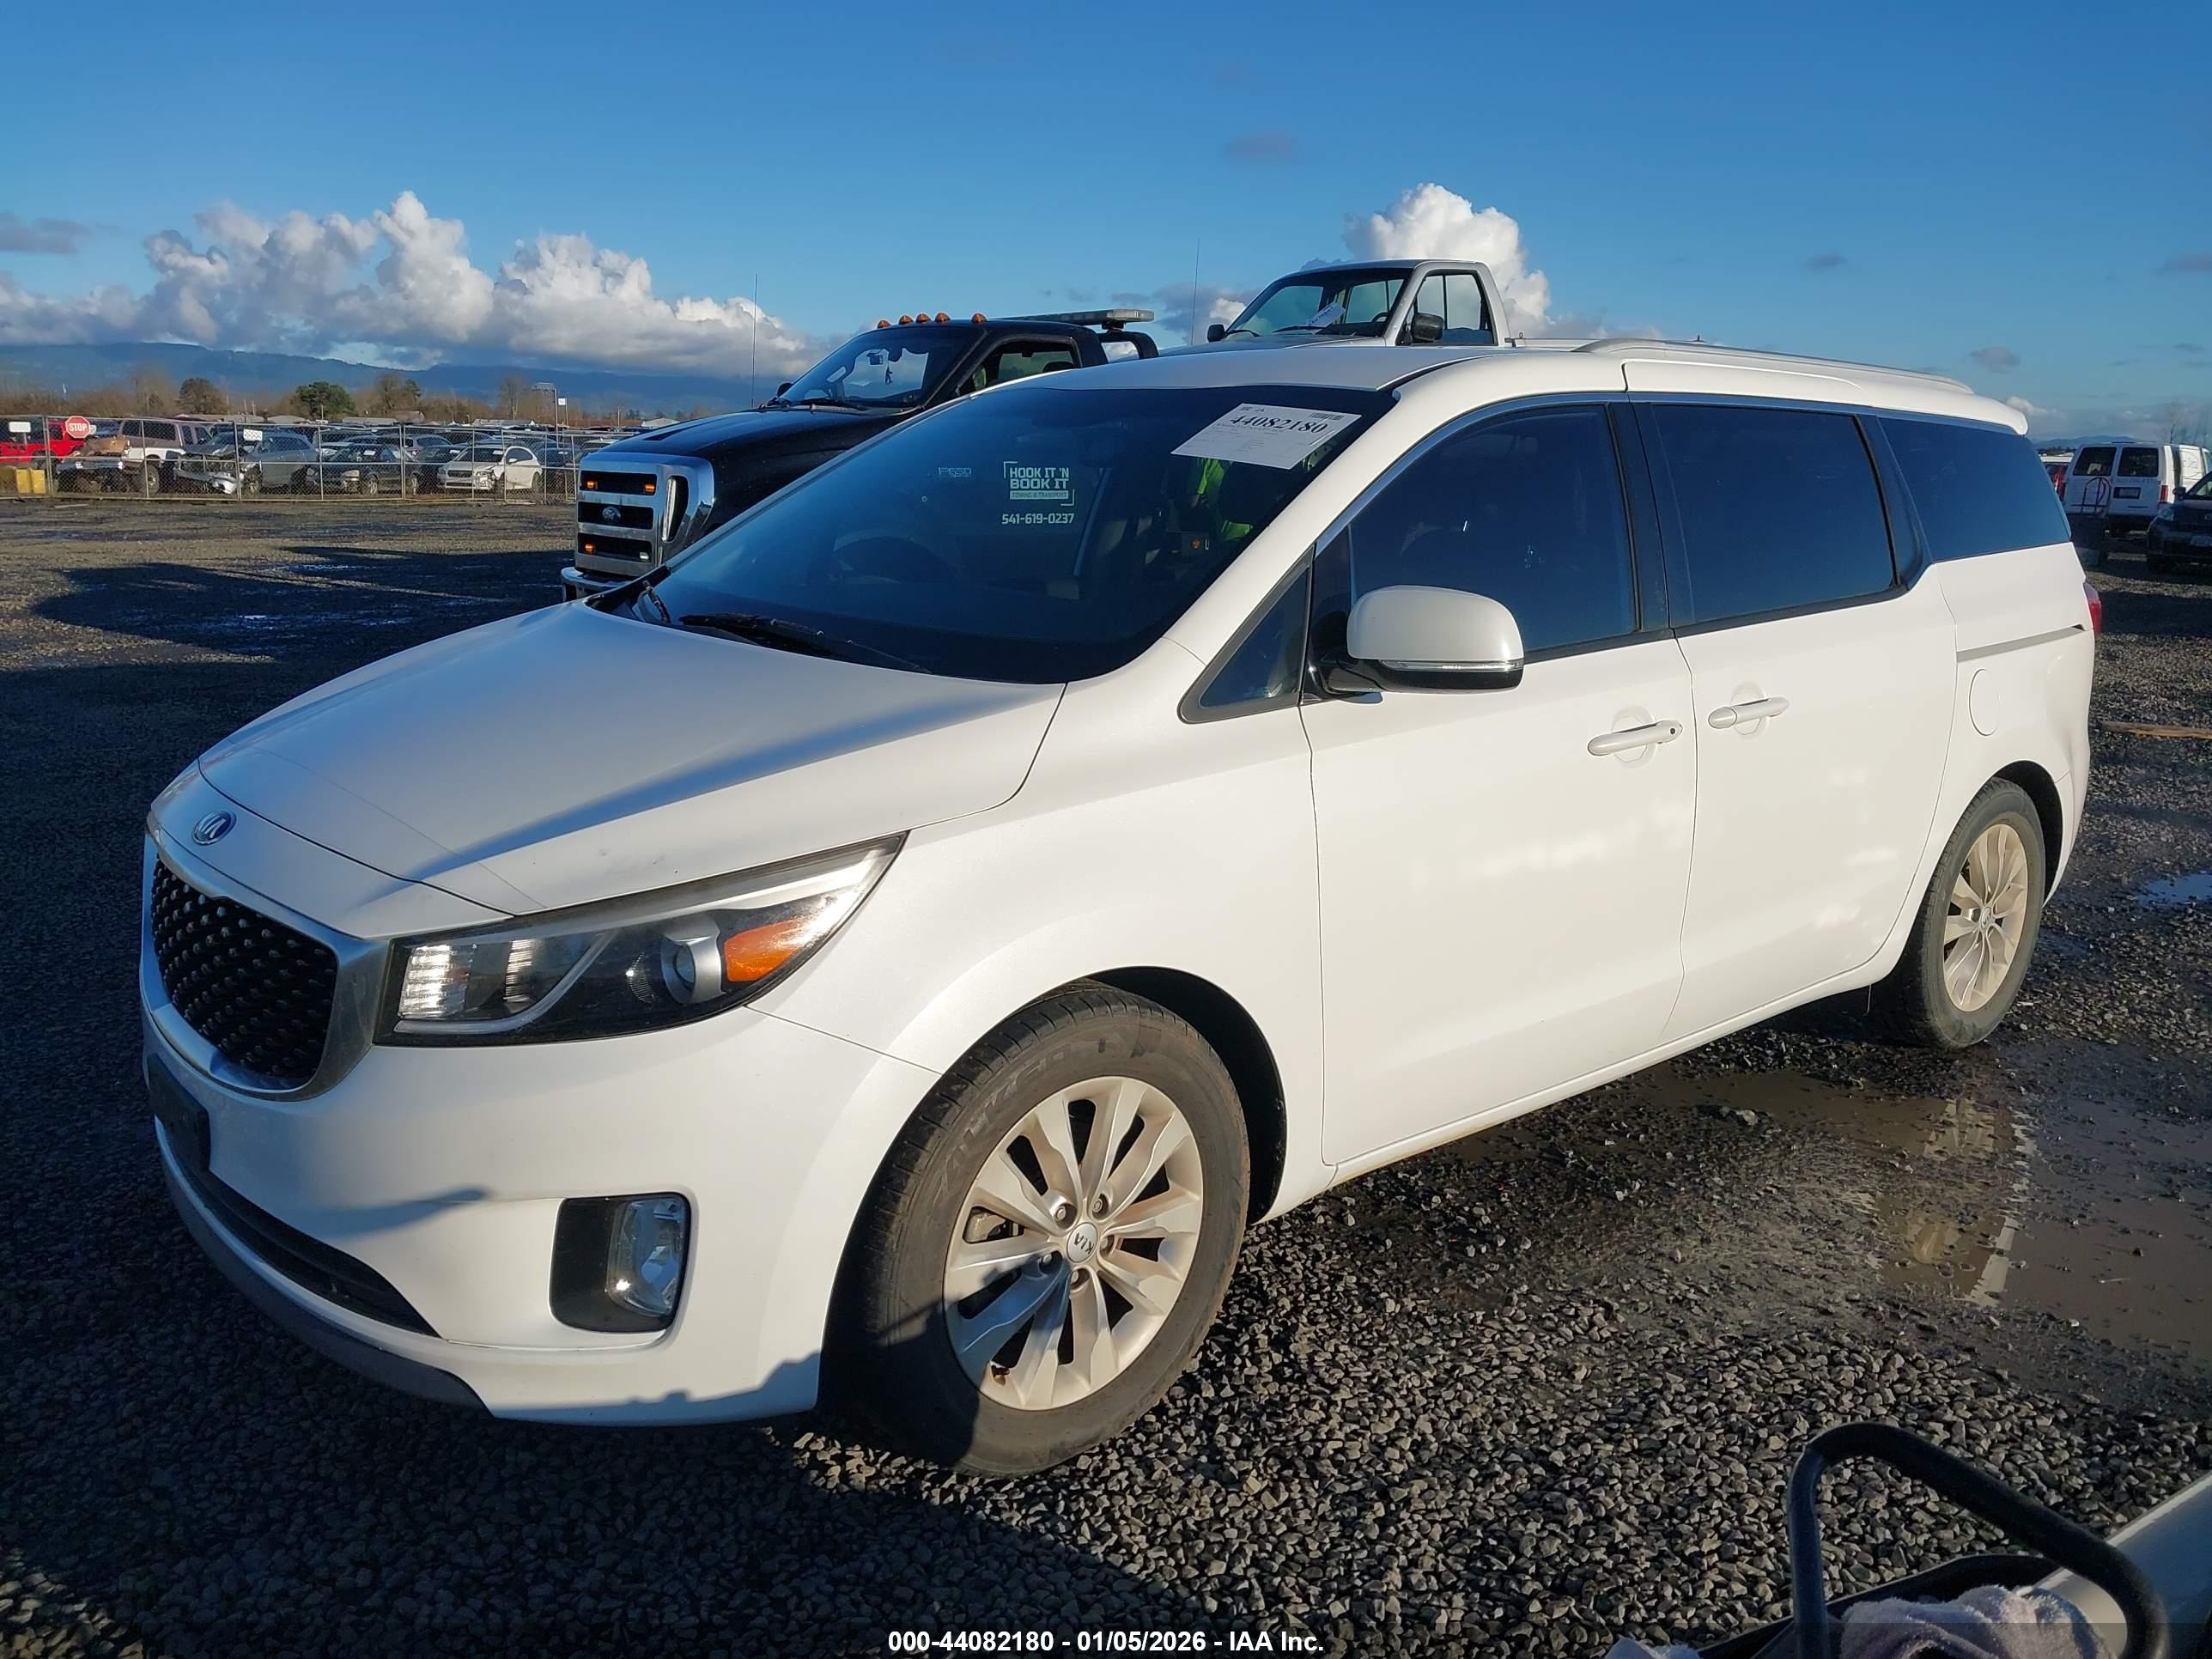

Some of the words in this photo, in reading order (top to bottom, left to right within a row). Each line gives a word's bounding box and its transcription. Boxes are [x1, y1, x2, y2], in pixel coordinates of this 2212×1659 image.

[69, 422, 88, 432] STOP
[1230, 414, 1329, 434] 44082180
[1010, 467, 1042, 478] HOOK
[1044, 467, 1056, 478] IT
[1059, 467, 1069, 478] 'N
[1010, 477, 1051, 489] BOOK
[1054, 477, 1070, 489] IT
[1001, 513, 1075, 525] 541-619-0237
[1073, 1231, 1095, 1255] KIA
